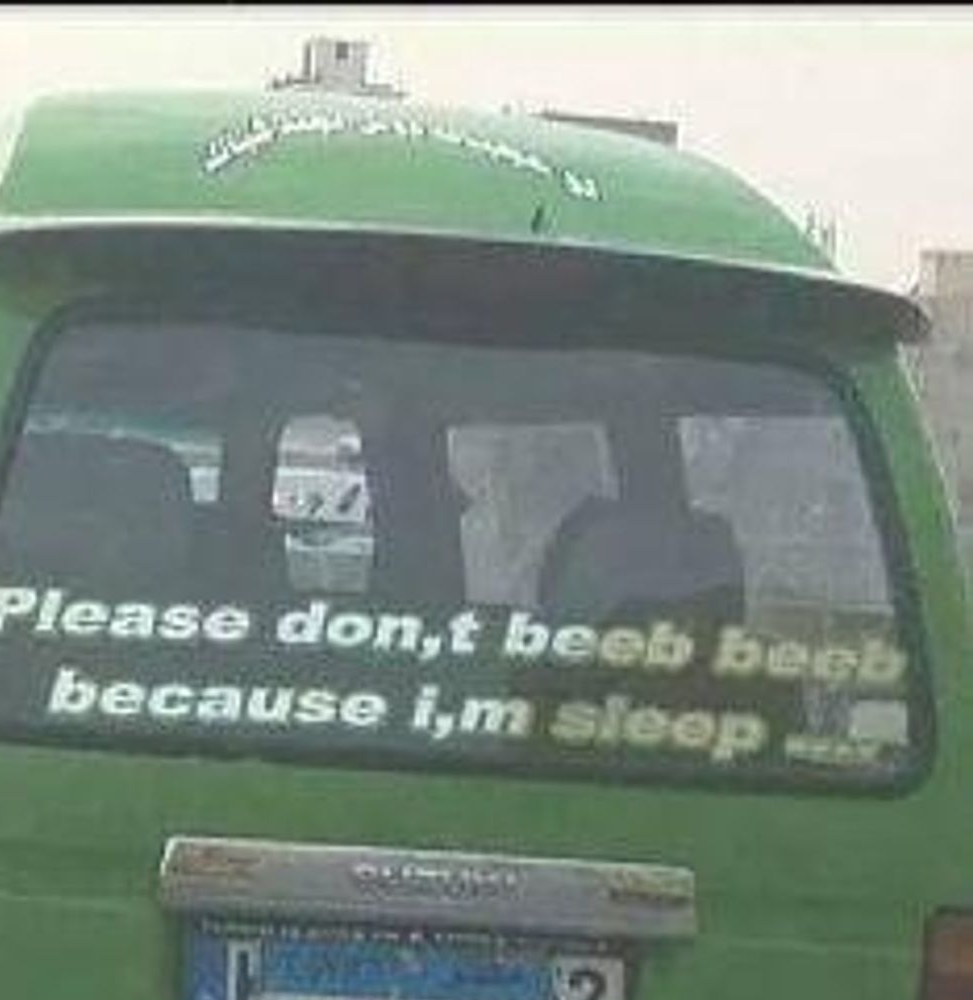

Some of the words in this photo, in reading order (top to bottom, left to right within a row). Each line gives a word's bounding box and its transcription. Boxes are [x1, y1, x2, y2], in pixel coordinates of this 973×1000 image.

[276, 600, 480, 660] don,t
[504, 611, 694, 674] beeb
[48, 666, 387, 726] because
[412, 684, 532, 740] i,m
[549, 697, 769, 762] sleep
